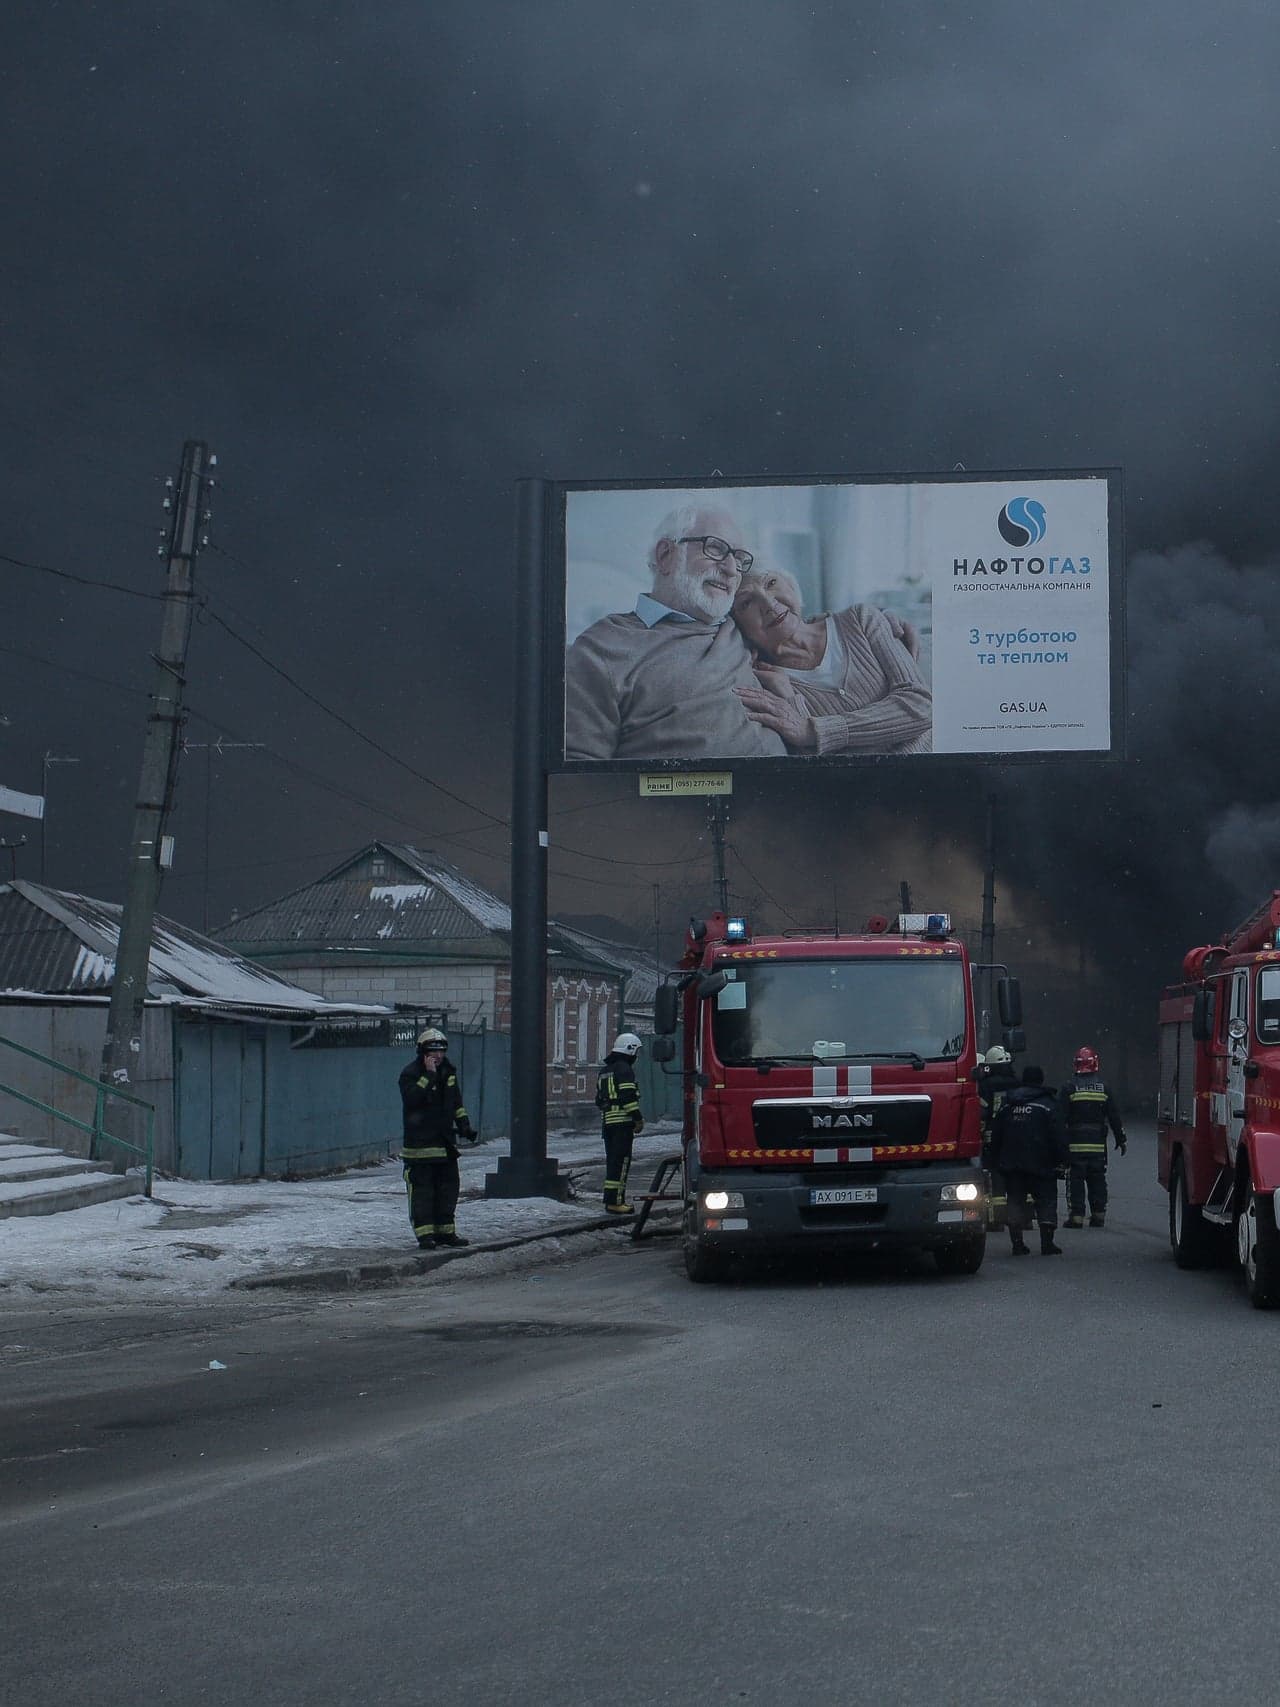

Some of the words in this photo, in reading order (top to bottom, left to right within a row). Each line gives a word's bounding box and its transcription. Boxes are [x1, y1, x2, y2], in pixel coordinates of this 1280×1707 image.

[953, 557, 1091, 576] НАФТОГАЗ
[953, 583, 1041, 592] ГАЗОПОСТАЧАЛЬНА
[1042, 582, 1091, 591] КОМПАНІЯ
[969, 628, 981, 645] З
[985, 628, 1077, 648] турботою
[977, 653, 996, 664] та
[1001, 652, 1068, 664] теплом
[999, 701, 1048, 713] GAS.UA
[812, 1114, 873, 1128] MAN
[818, 1192, 832, 1202] AX
[834, 1191, 852, 1202] 091
